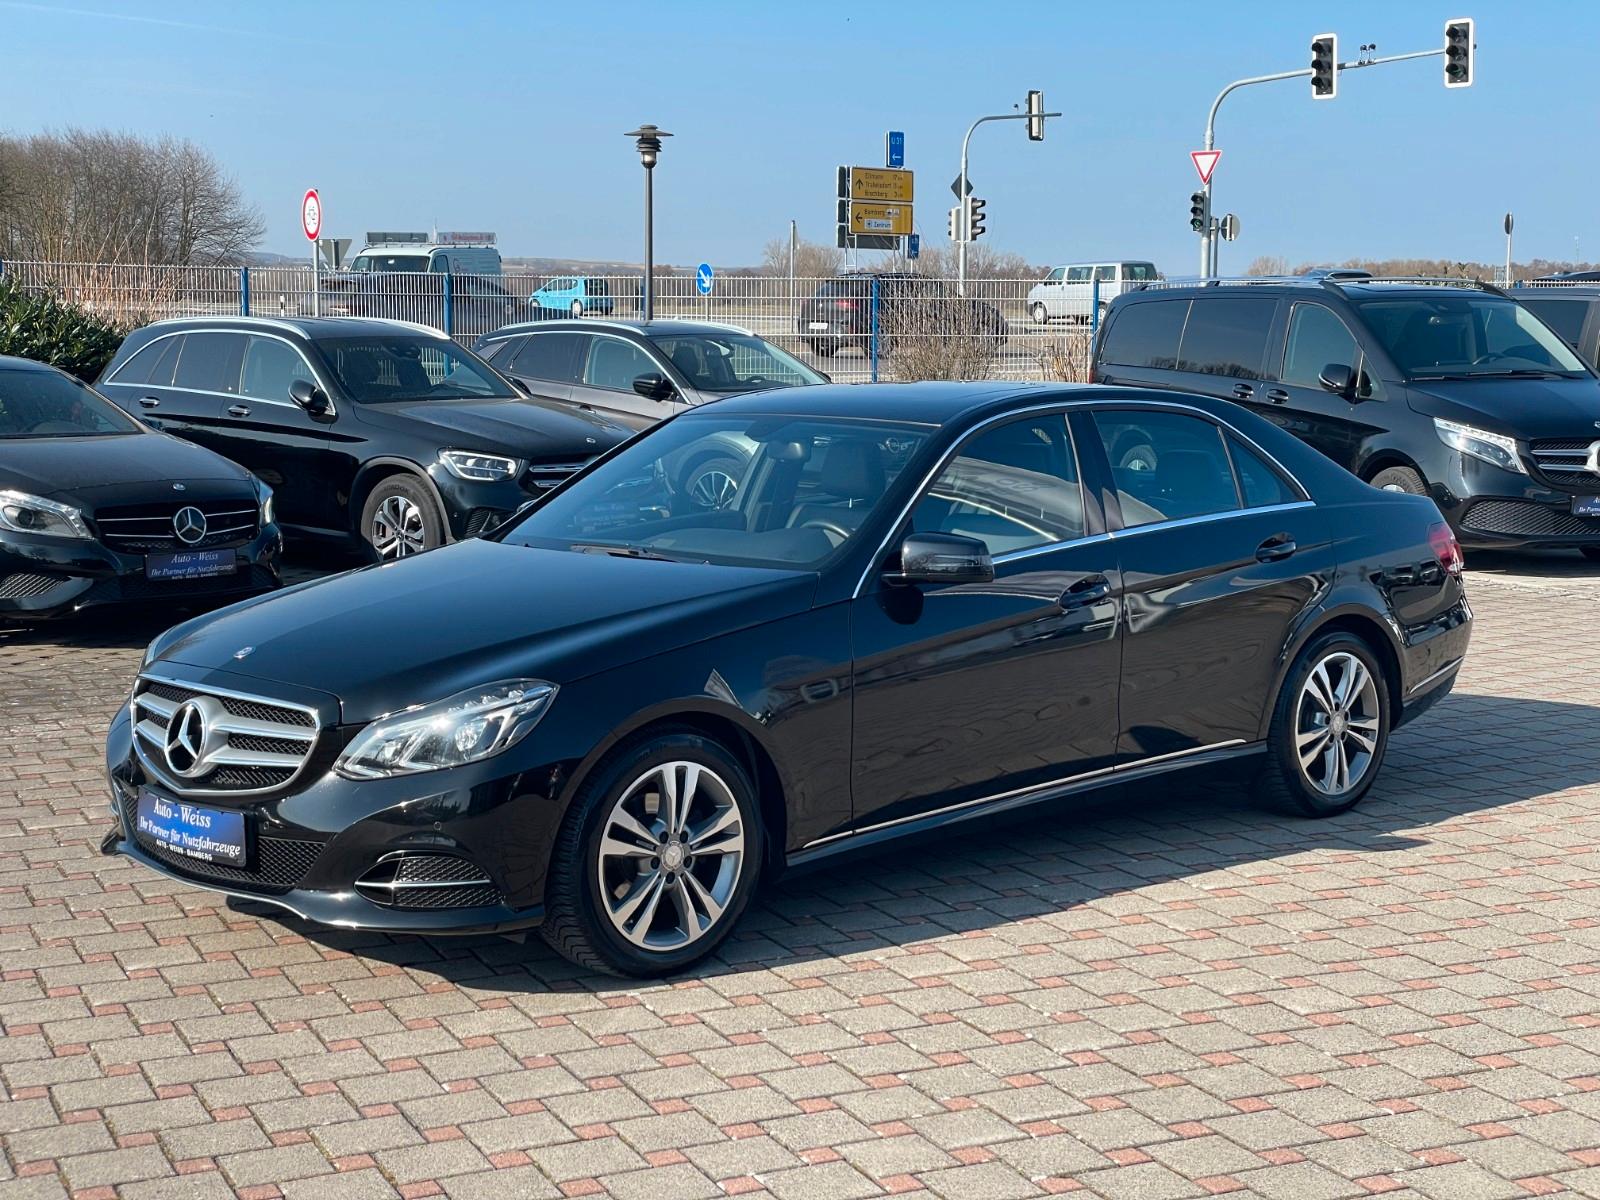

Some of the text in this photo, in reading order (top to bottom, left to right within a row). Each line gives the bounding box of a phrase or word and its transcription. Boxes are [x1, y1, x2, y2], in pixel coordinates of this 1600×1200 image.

[171, 554, 191, 564] Auto
[199, 552, 218, 561] Weiss
[154, 798, 172, 819] Auto
[181, 806, 211, 828] Weiss
[140, 815, 241, 857] Ihr Partner für Nutzfahrzeuge
[156, 838, 167, 849] AUTO
[186, 848, 213, 861] BAMBERG
